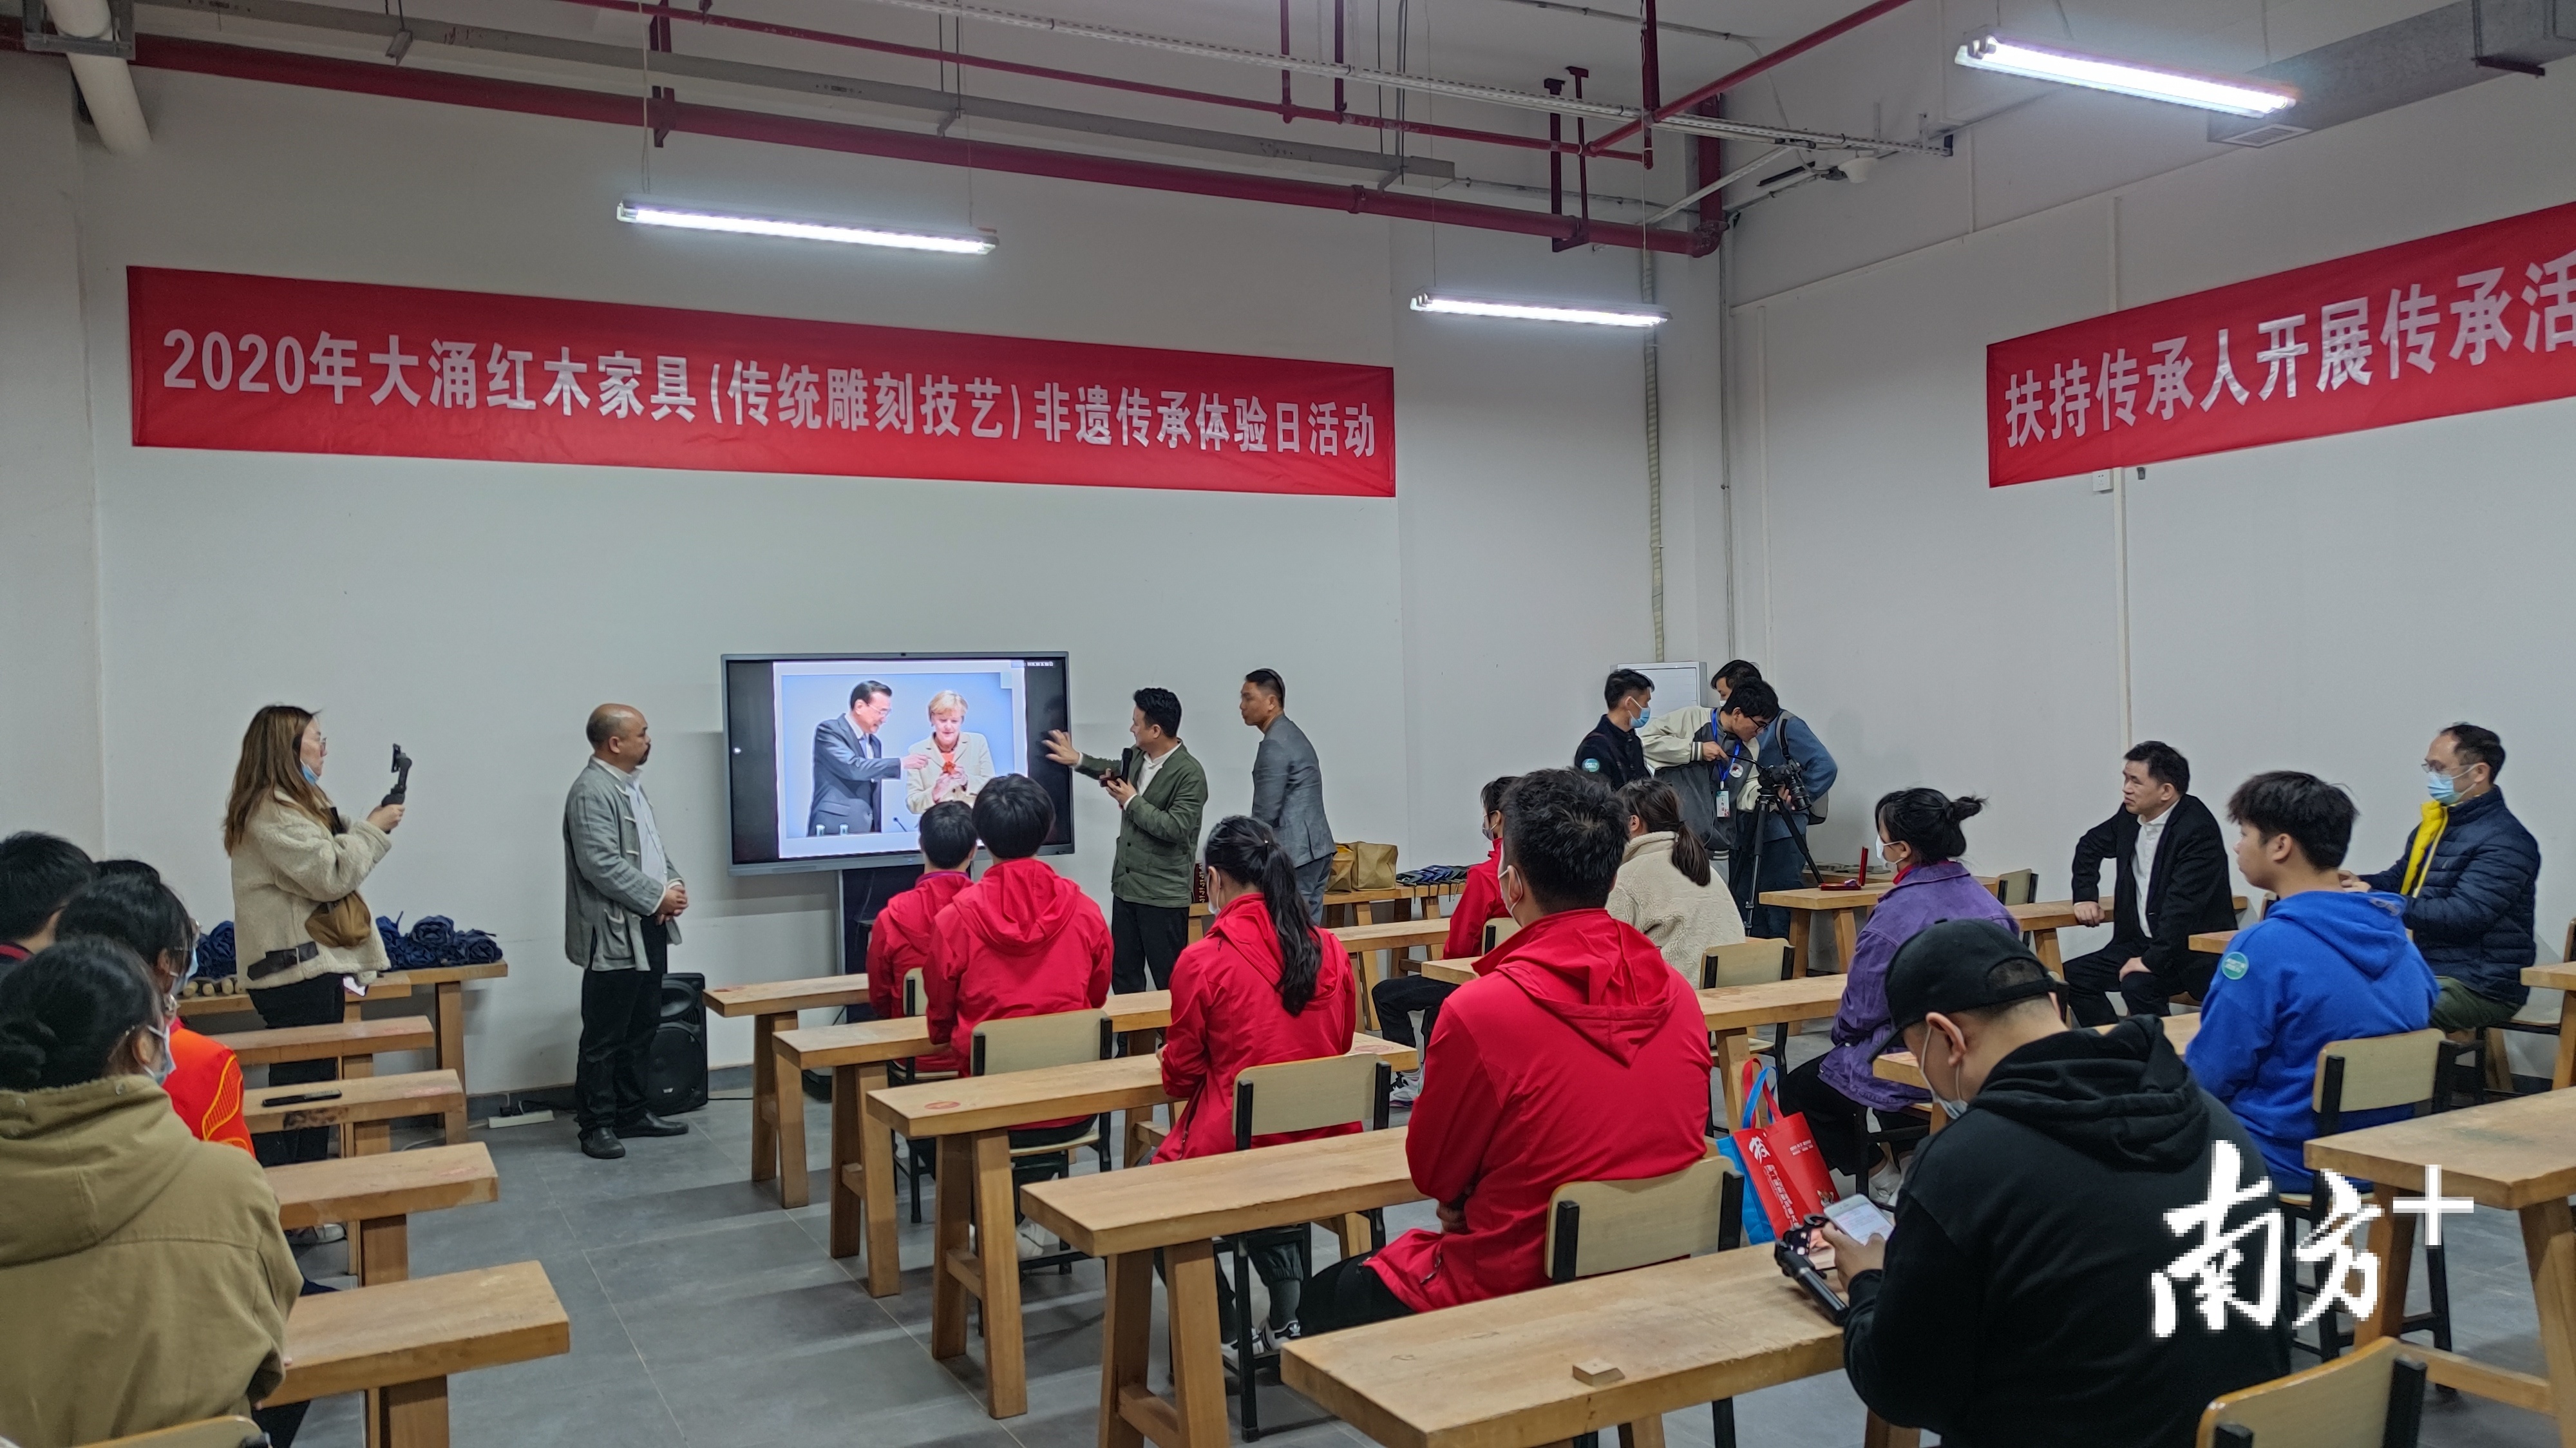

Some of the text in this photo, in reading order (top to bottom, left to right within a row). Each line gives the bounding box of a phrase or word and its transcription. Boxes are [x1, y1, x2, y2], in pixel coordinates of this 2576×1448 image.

[2005, 249, 2576, 448] 扶持传承人开展传承活
